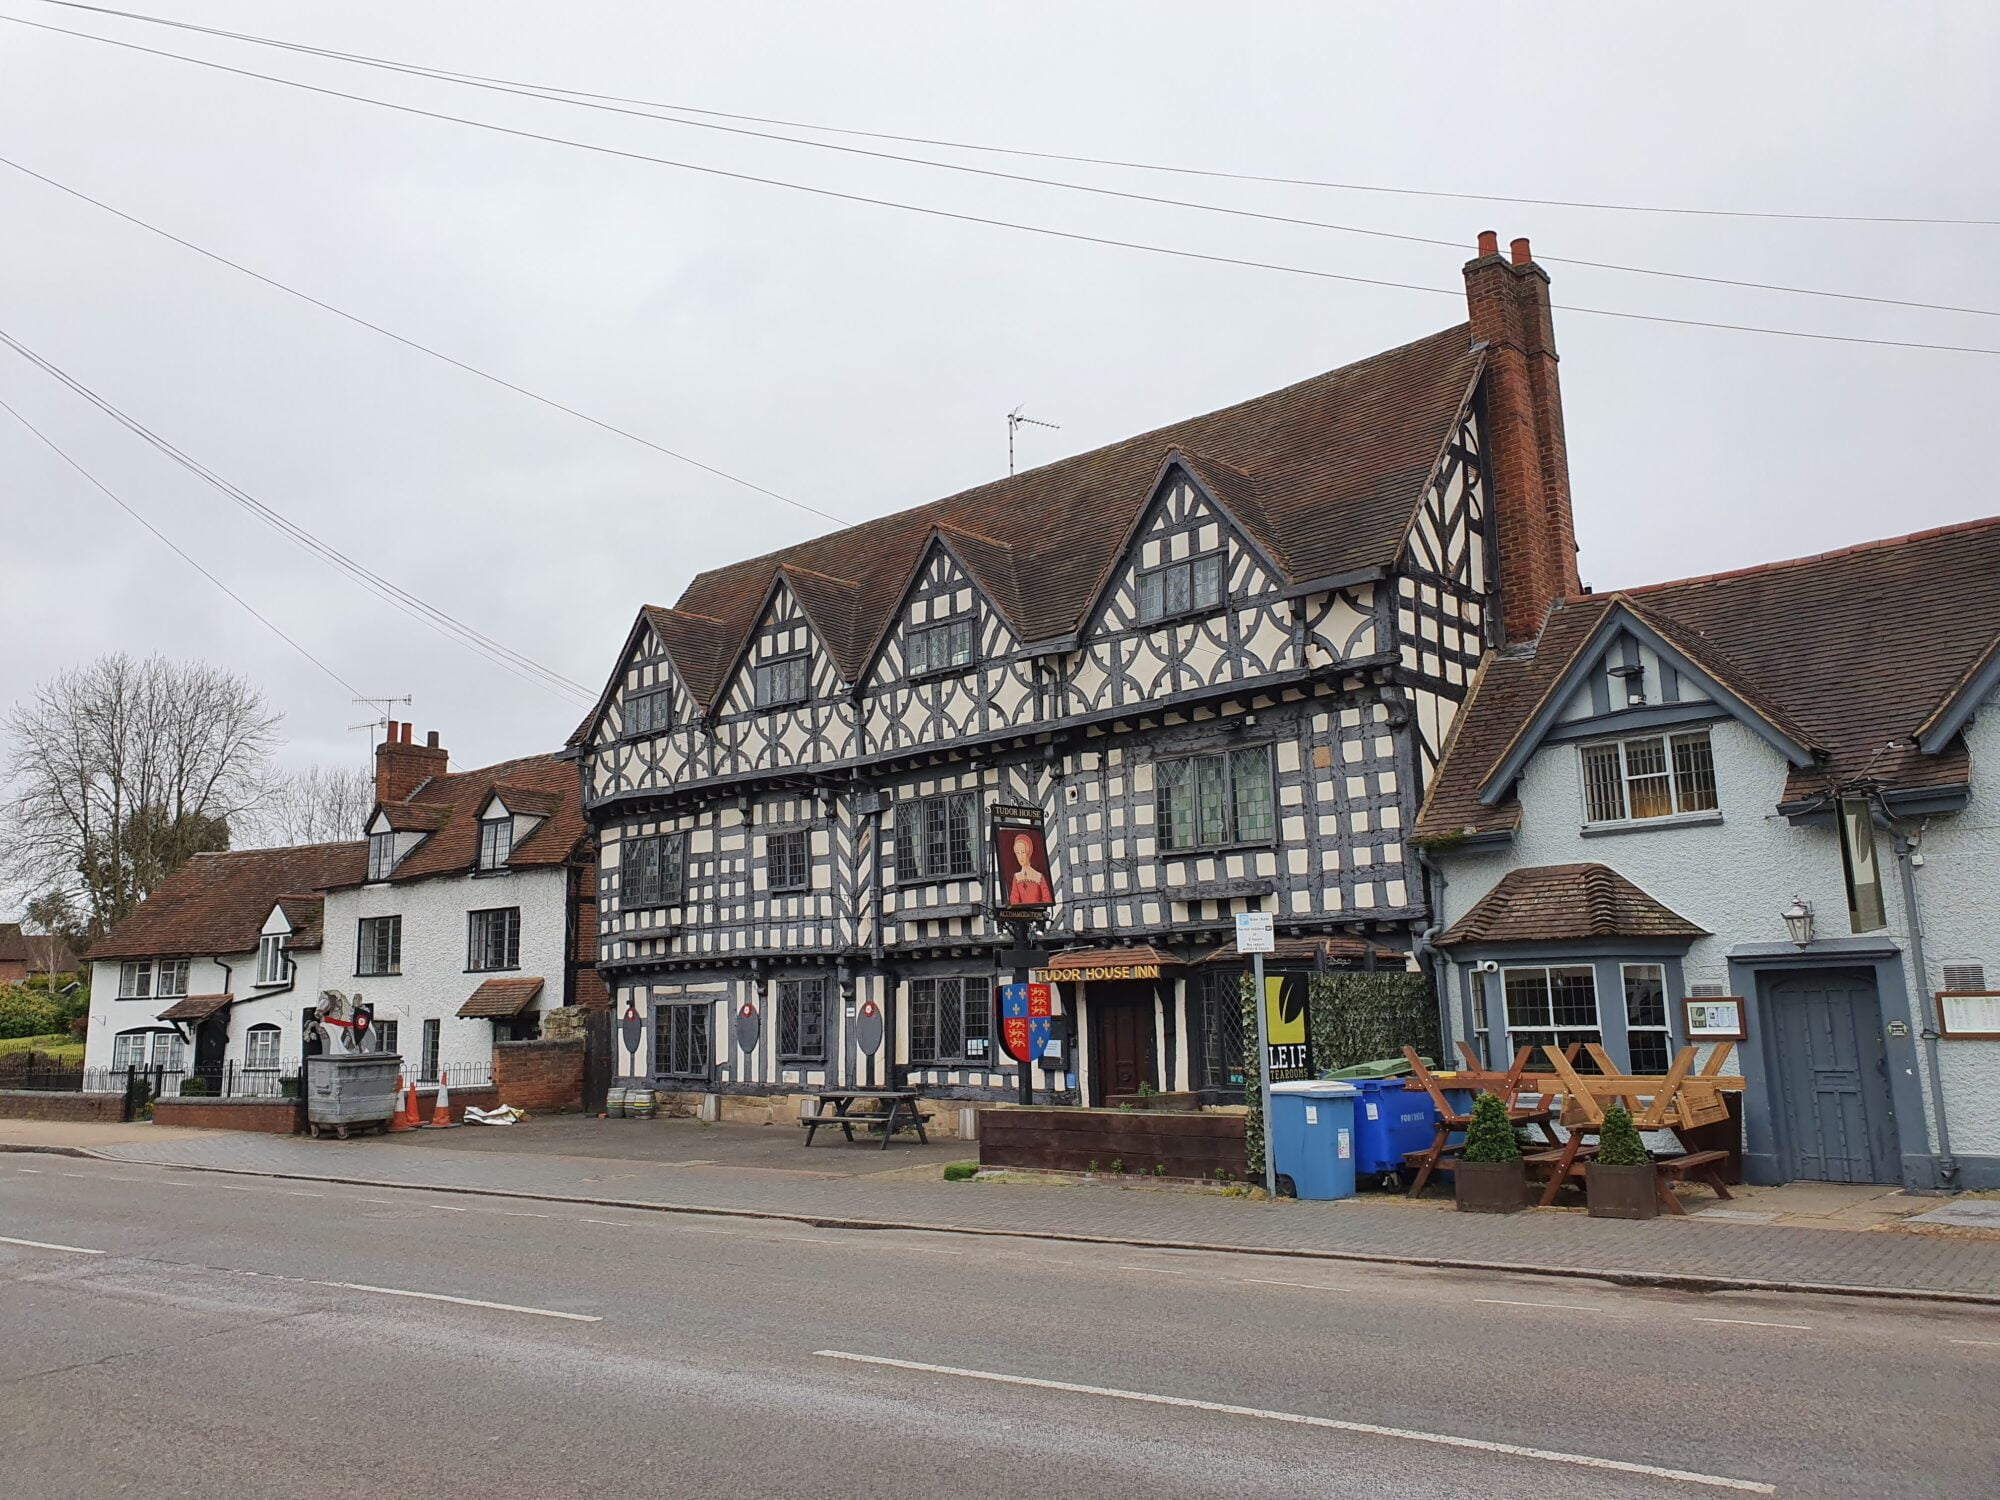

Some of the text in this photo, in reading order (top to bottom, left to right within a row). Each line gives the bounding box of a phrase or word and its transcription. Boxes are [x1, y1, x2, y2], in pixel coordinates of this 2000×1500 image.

[995, 806, 1042, 818] TUDOR HOUSE
[1036, 965, 1159, 981] TUDOR HOUSE INN
[1268, 1045, 1307, 1069] LEIF
[1270, 1067, 1309, 1080] TEAROOMS
